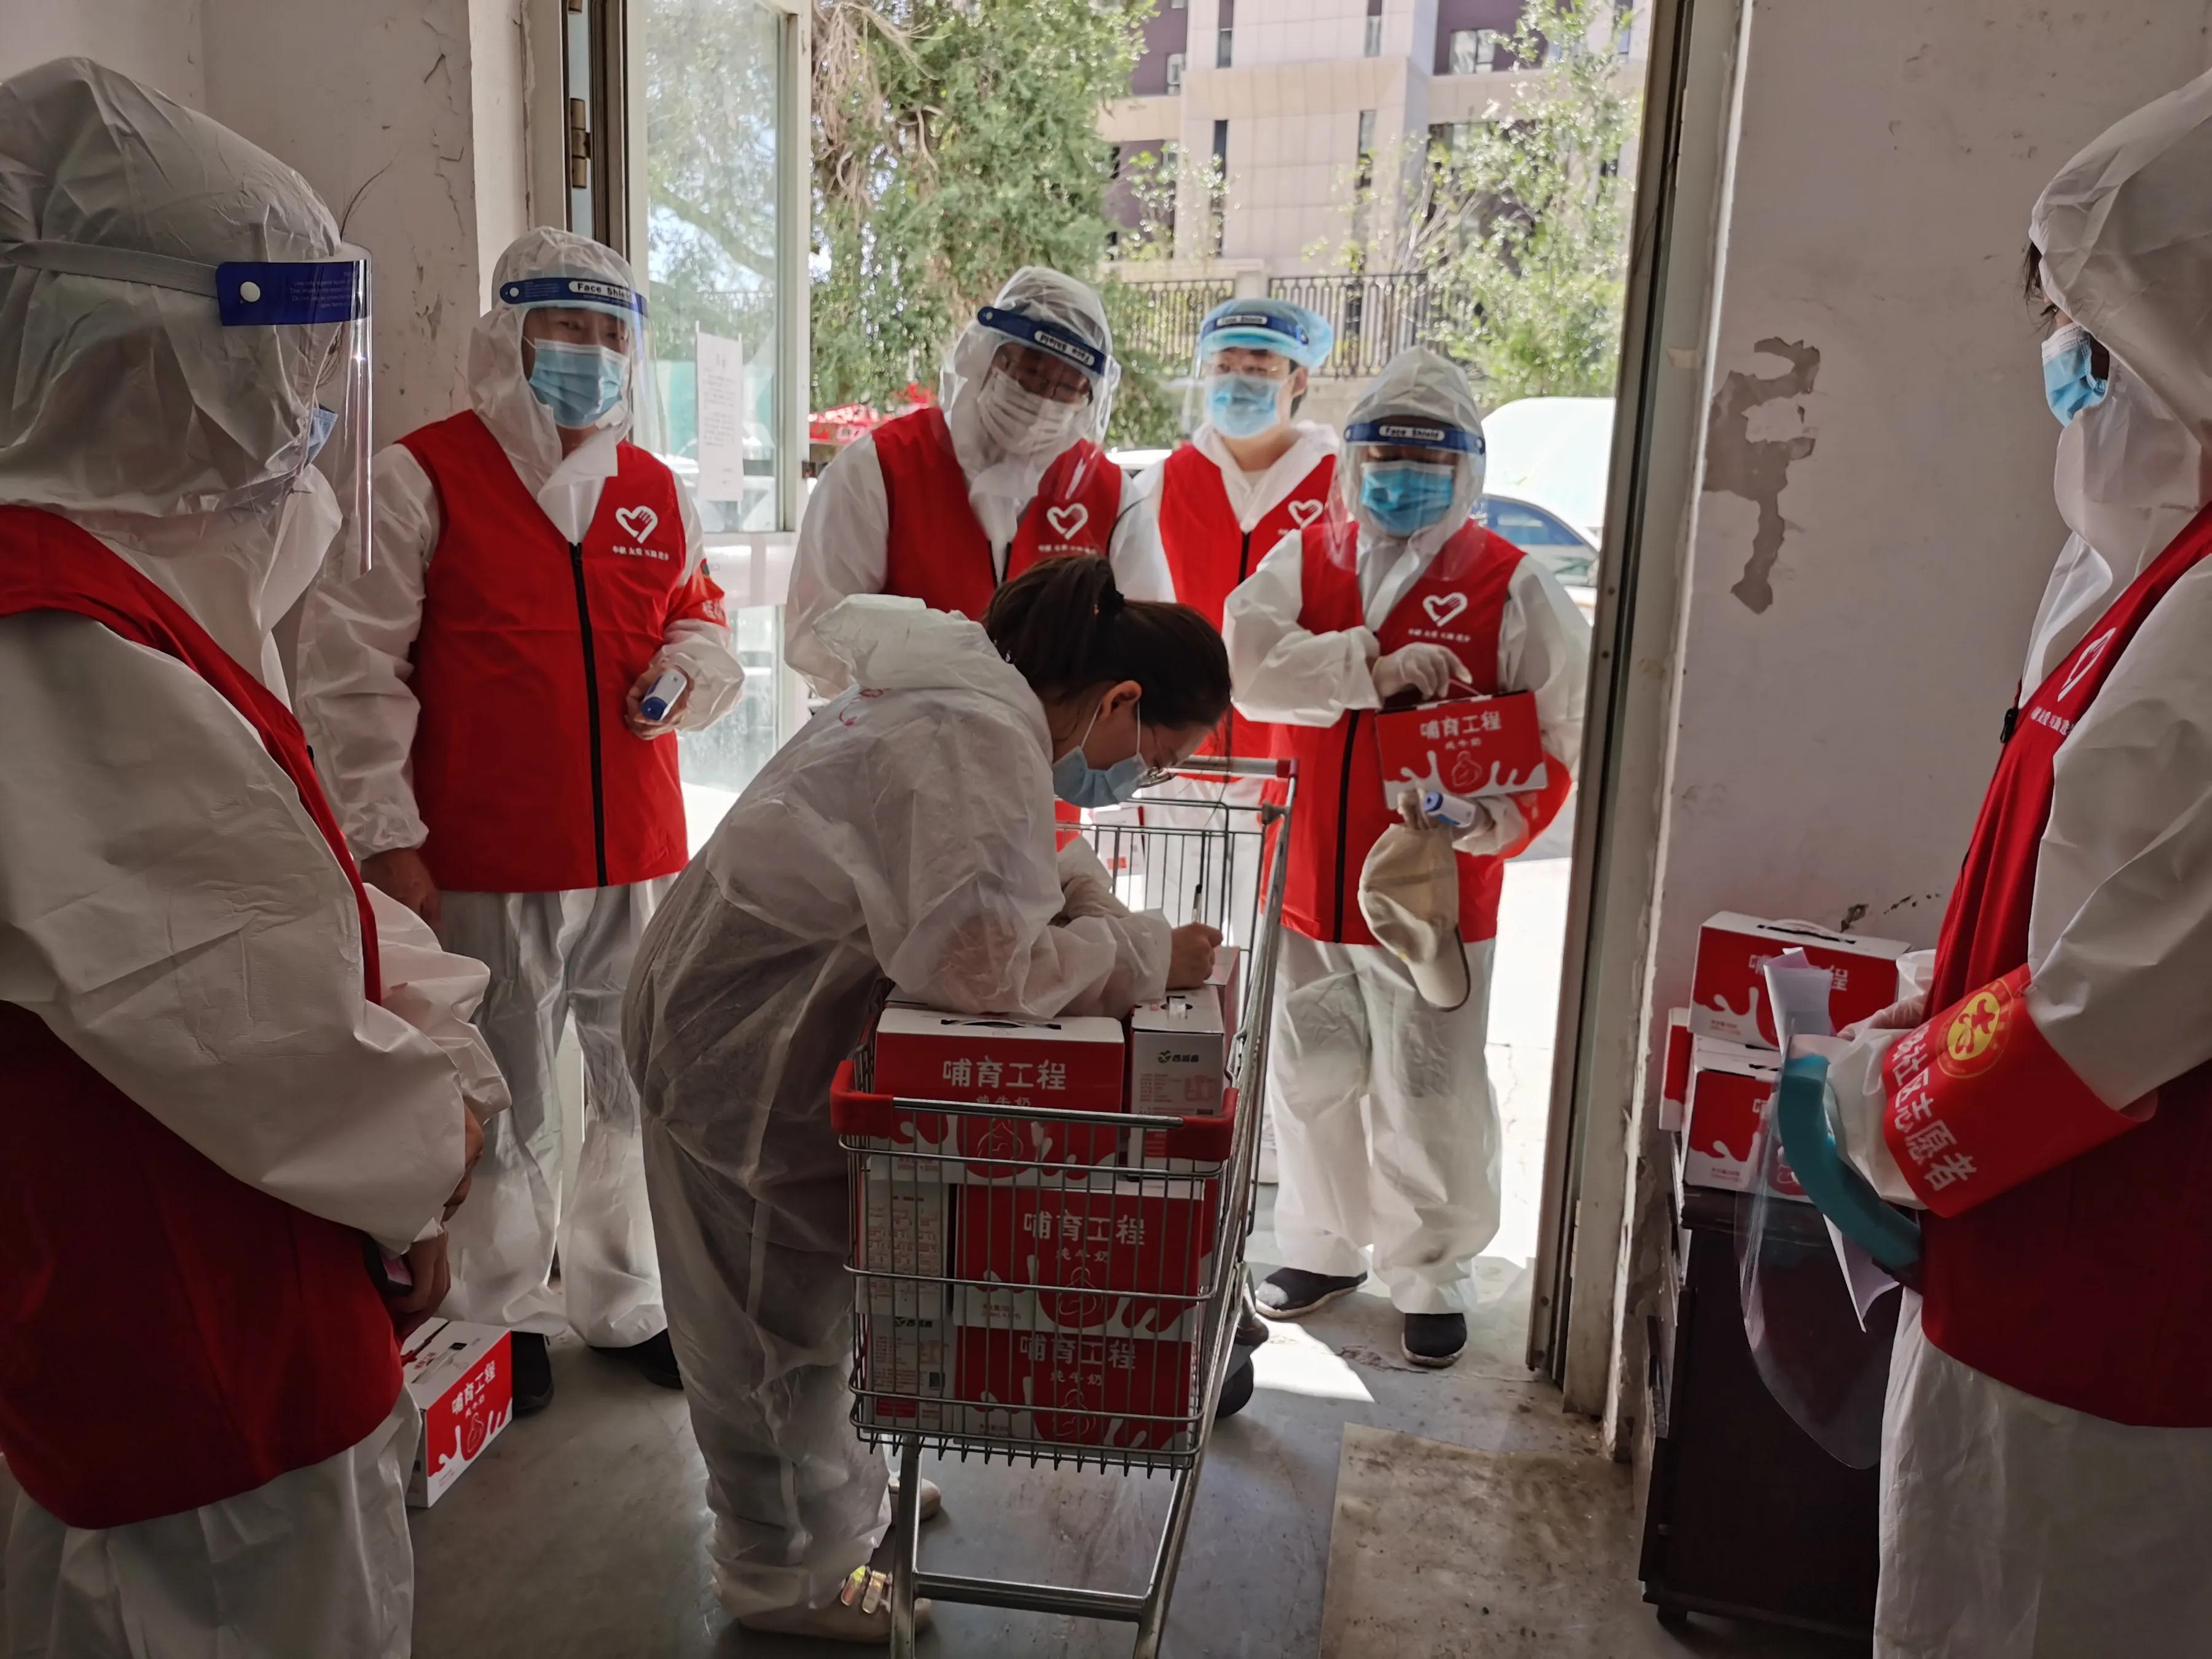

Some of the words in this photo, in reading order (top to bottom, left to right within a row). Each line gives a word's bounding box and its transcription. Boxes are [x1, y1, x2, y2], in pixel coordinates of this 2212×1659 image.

[578, 283, 602, 292] Face
[1419, 711, 1502, 739] 哺育工程
[943, 1055, 1066, 1090] 哺育工程
[1023, 1209, 1145, 1245] 哺育工程
[1020, 1332, 1136, 1369] 哺育工程
